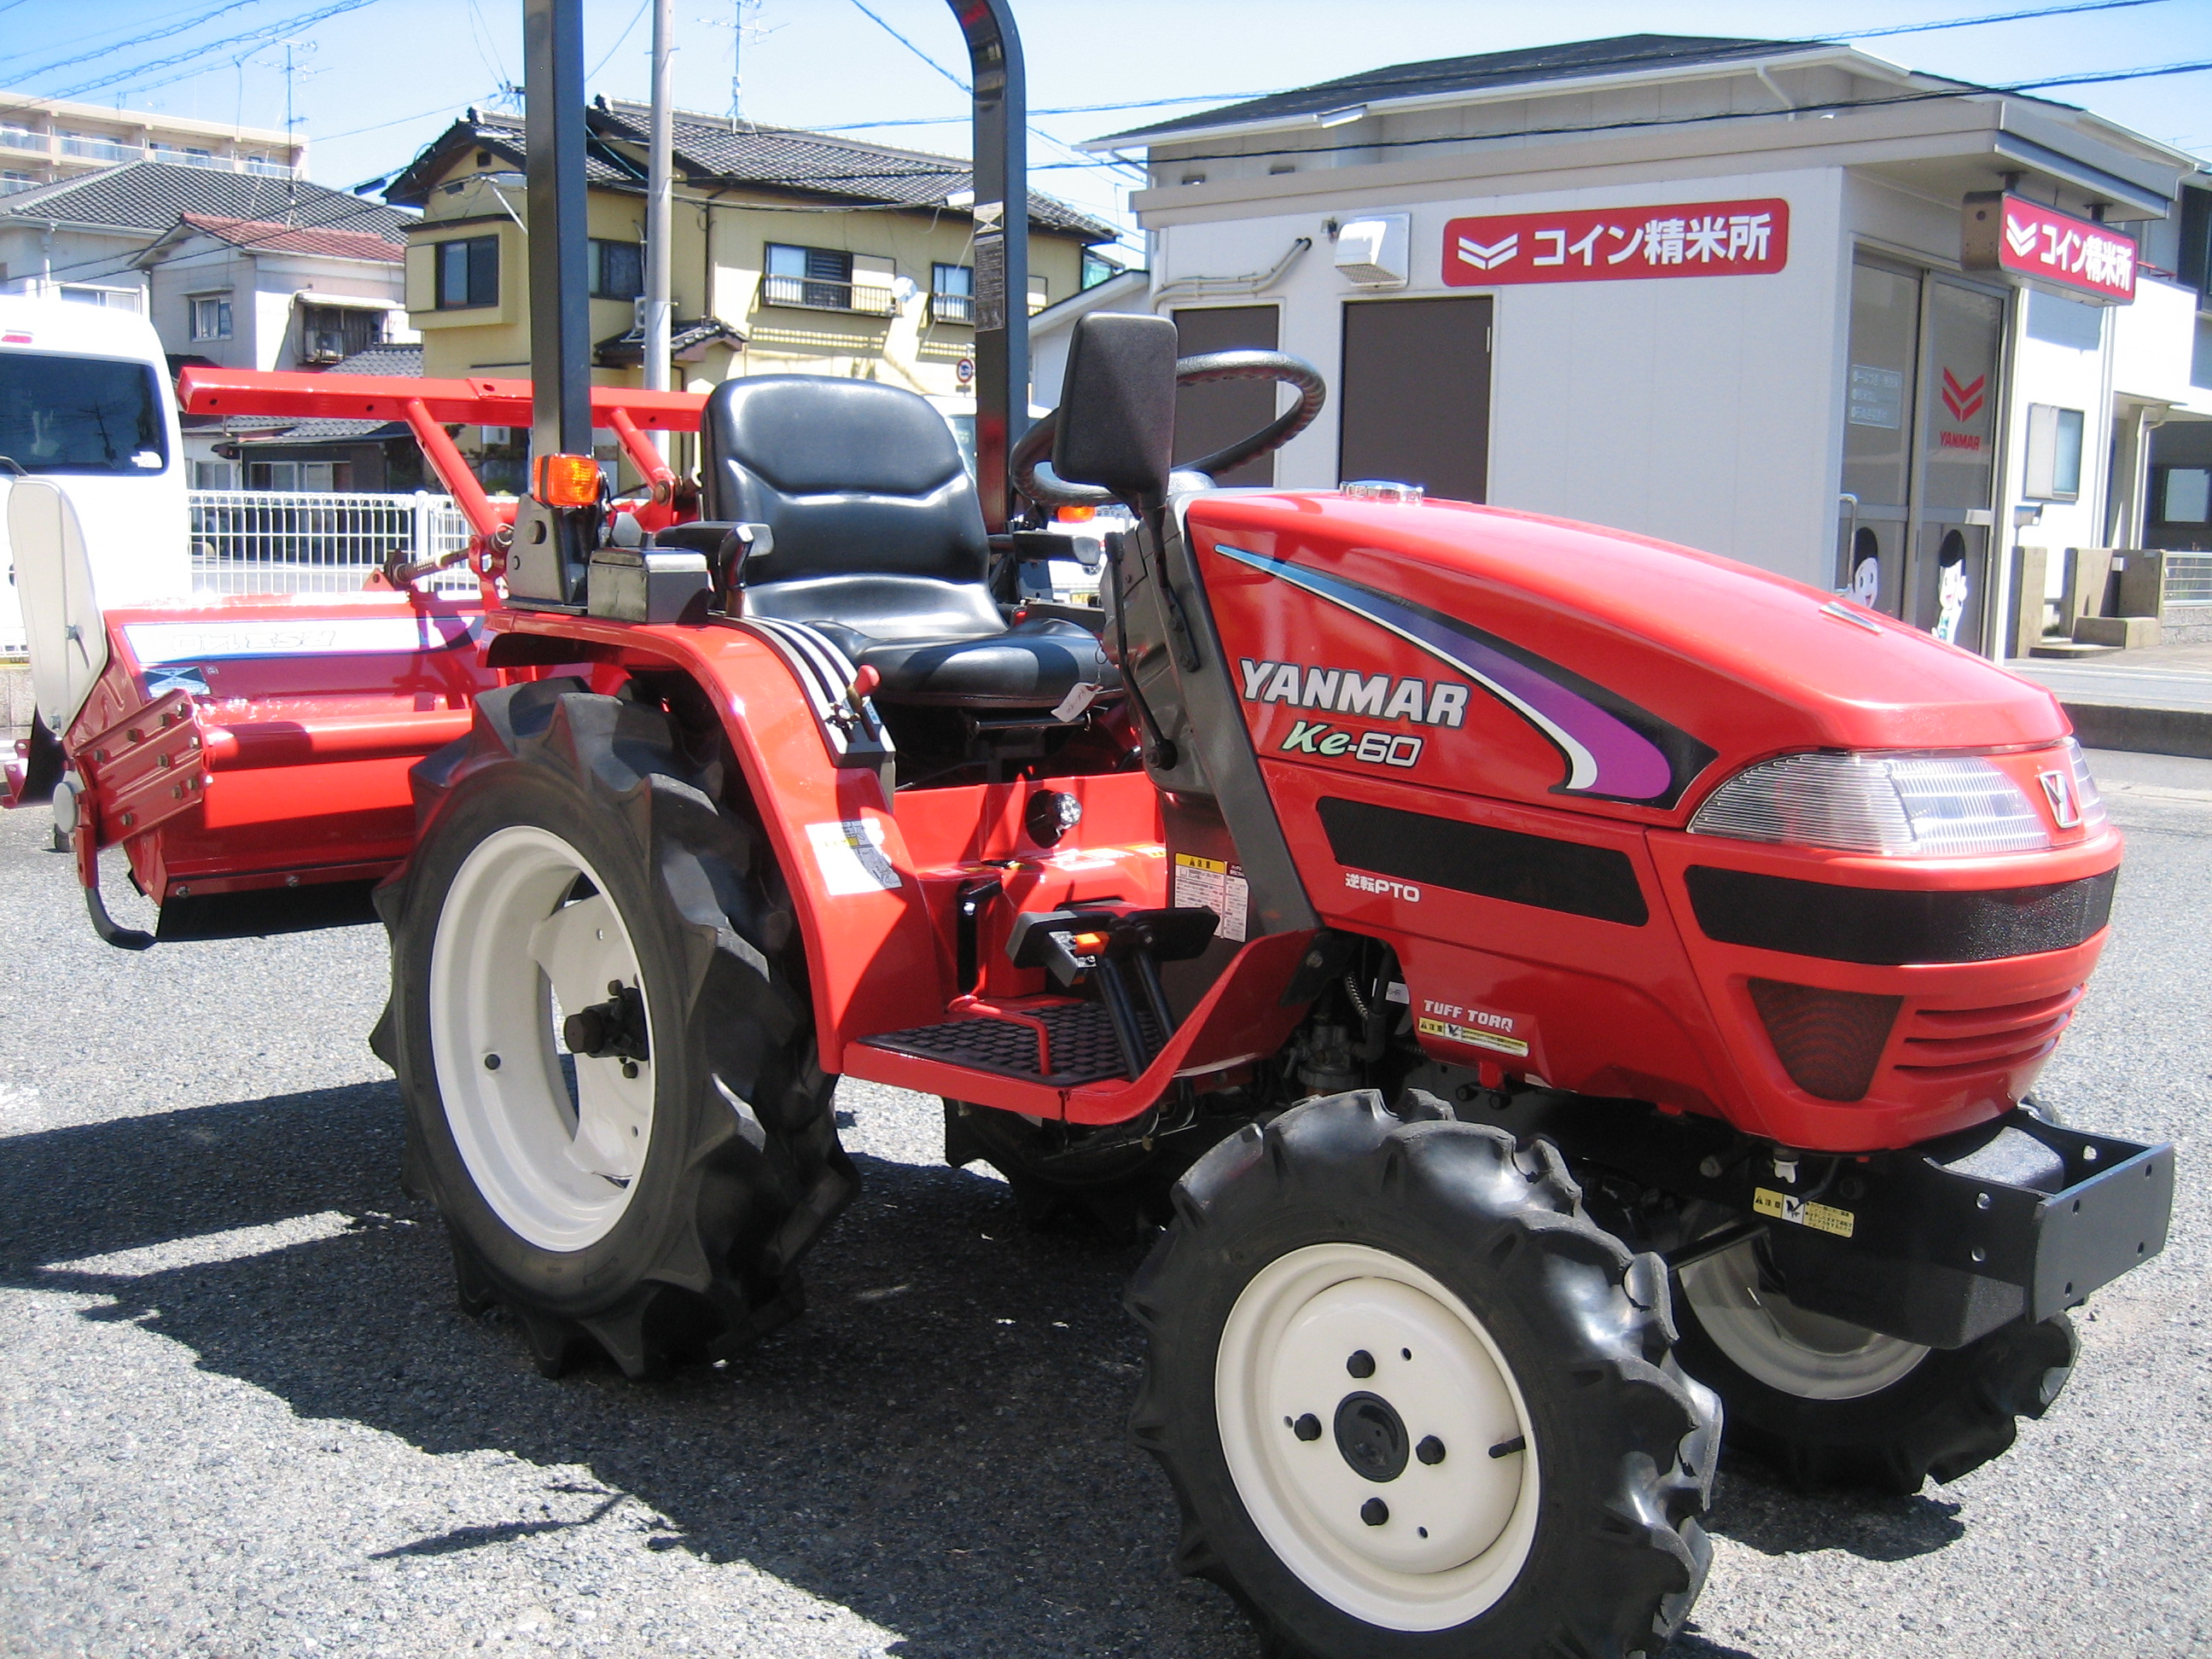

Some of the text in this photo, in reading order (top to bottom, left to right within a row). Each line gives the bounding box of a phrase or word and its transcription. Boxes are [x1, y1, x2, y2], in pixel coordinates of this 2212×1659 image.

[1533, 212, 1772, 266] コイン精米所
[2039, 224, 2133, 292] コイン精米所
[1940, 431, 1981, 451] YANMAR
[1240, 658, 1470, 728] YANMAR
[1282, 720, 1423, 768] Ke-60
[1345, 872, 1420, 903] 逆転PTO
[1423, 999, 1514, 1033] TUFF TORQ
